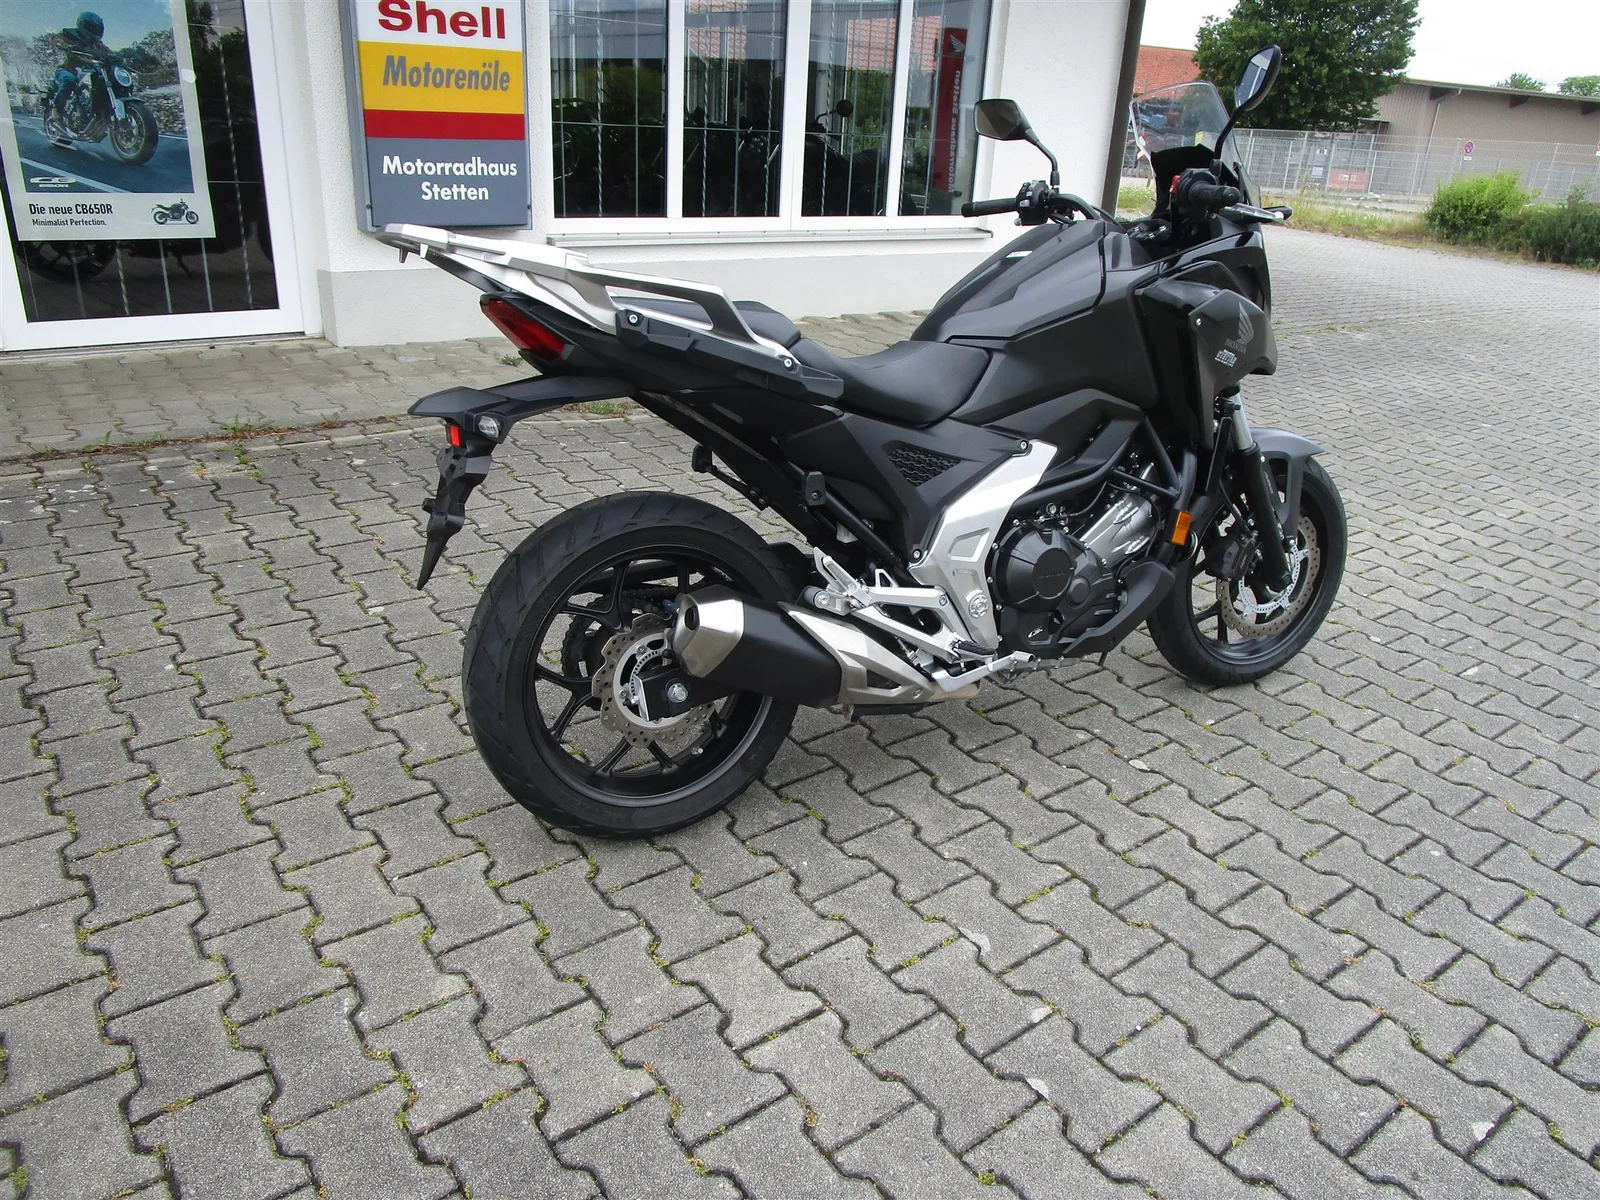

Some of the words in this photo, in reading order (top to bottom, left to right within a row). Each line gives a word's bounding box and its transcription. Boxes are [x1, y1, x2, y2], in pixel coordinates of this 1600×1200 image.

[378, 0, 506, 39] Shell
[383, 54, 511, 92] Motorenöle
[382, 155, 518, 176] Motorradhaus
[421, 181, 489, 201] Stetten
[29, 204, 46, 215] Die
[48, 206, 73, 215] neue
[75, 204, 113, 215] CB650R
[32, 218, 69, 227] Minimalist
[1225, 338, 1247, 354] HONDA
